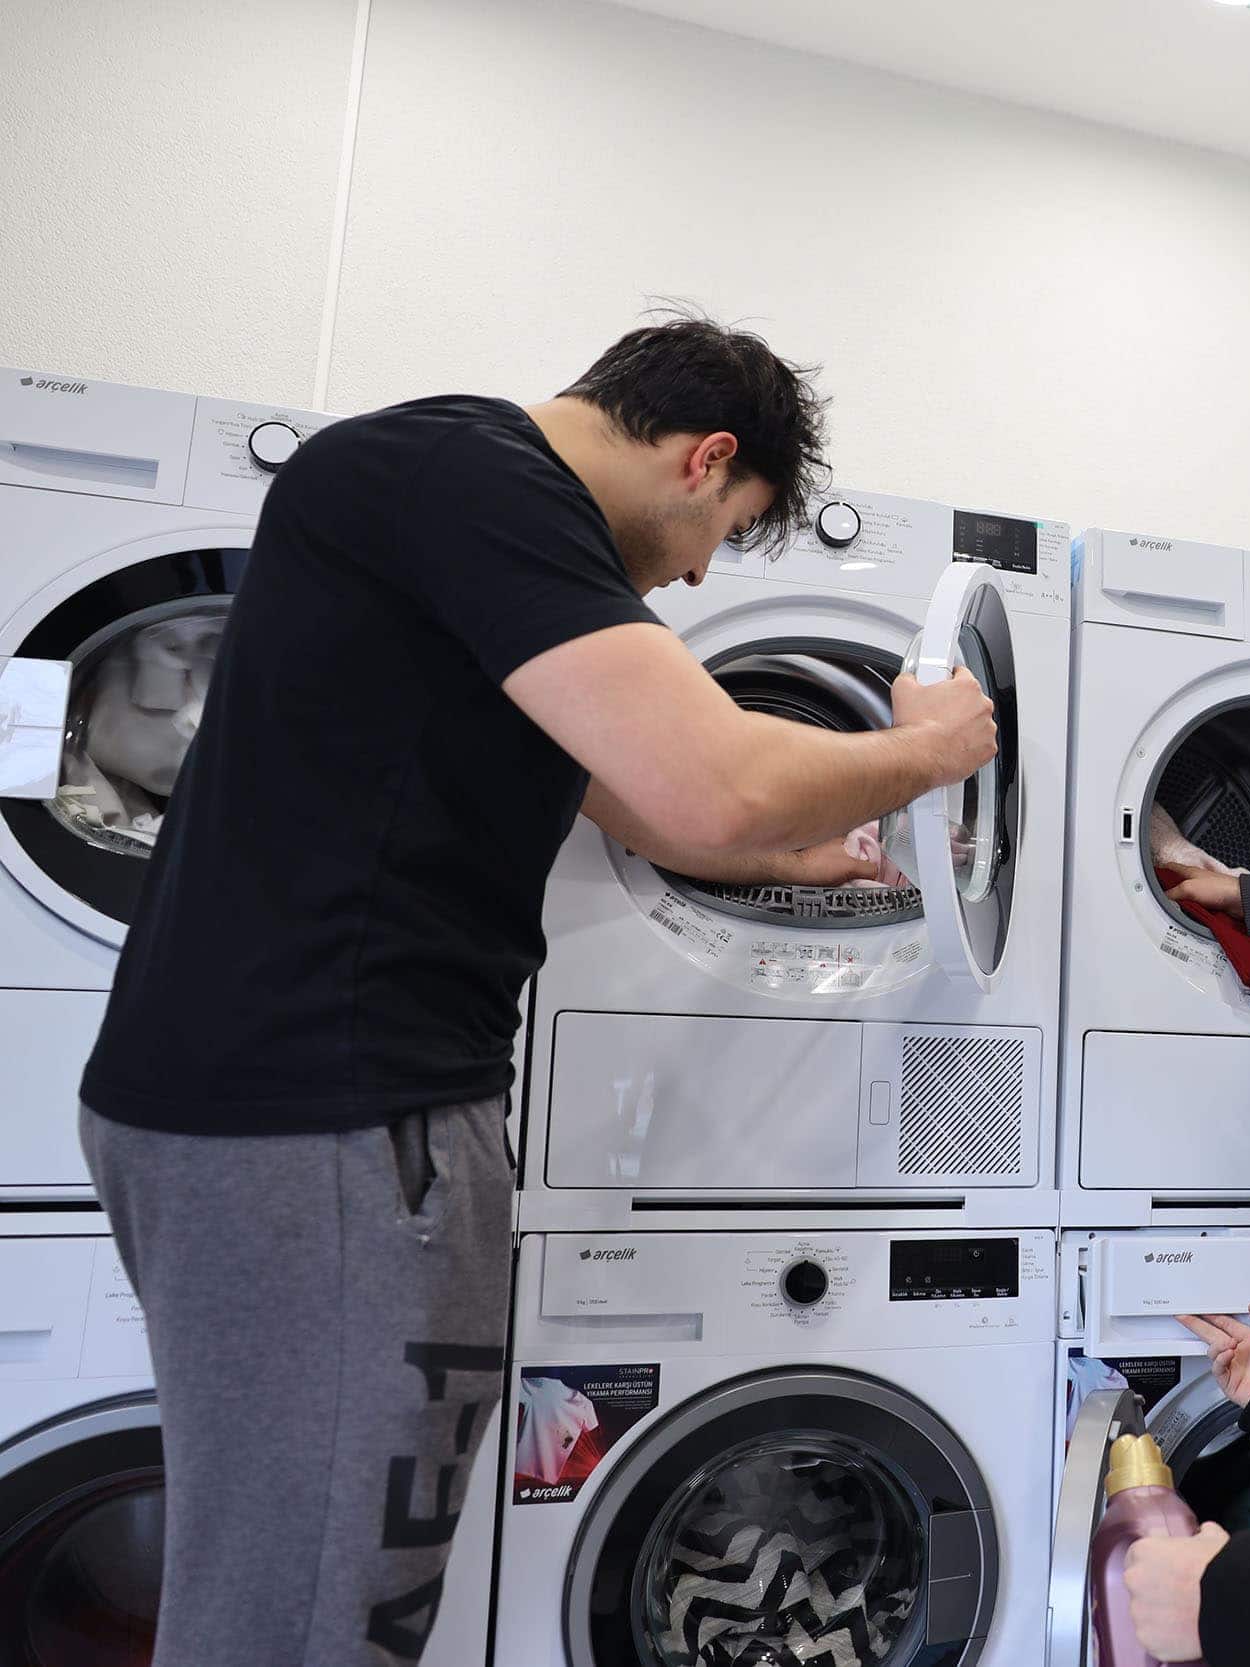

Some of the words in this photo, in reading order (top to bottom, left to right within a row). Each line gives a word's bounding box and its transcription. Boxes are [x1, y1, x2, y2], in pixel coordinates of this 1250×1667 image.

[36, 377, 89, 395] arçelik
[1139, 537, 1174, 552] arçelik
[593, 1247, 638, 1263] arçelik
[1155, 1251, 1194, 1266] arçelik
[583, 1381, 614, 1390] LEKELERE
[614, 1381, 632, 1390] KARŞI
[632, 1380, 653, 1389] ÜSTÜN
[586, 1389, 610, 1397] YIKAMA
[610, 1388, 653, 1397] PERFORMANSI
[531, 1484, 573, 1500] arçelik
